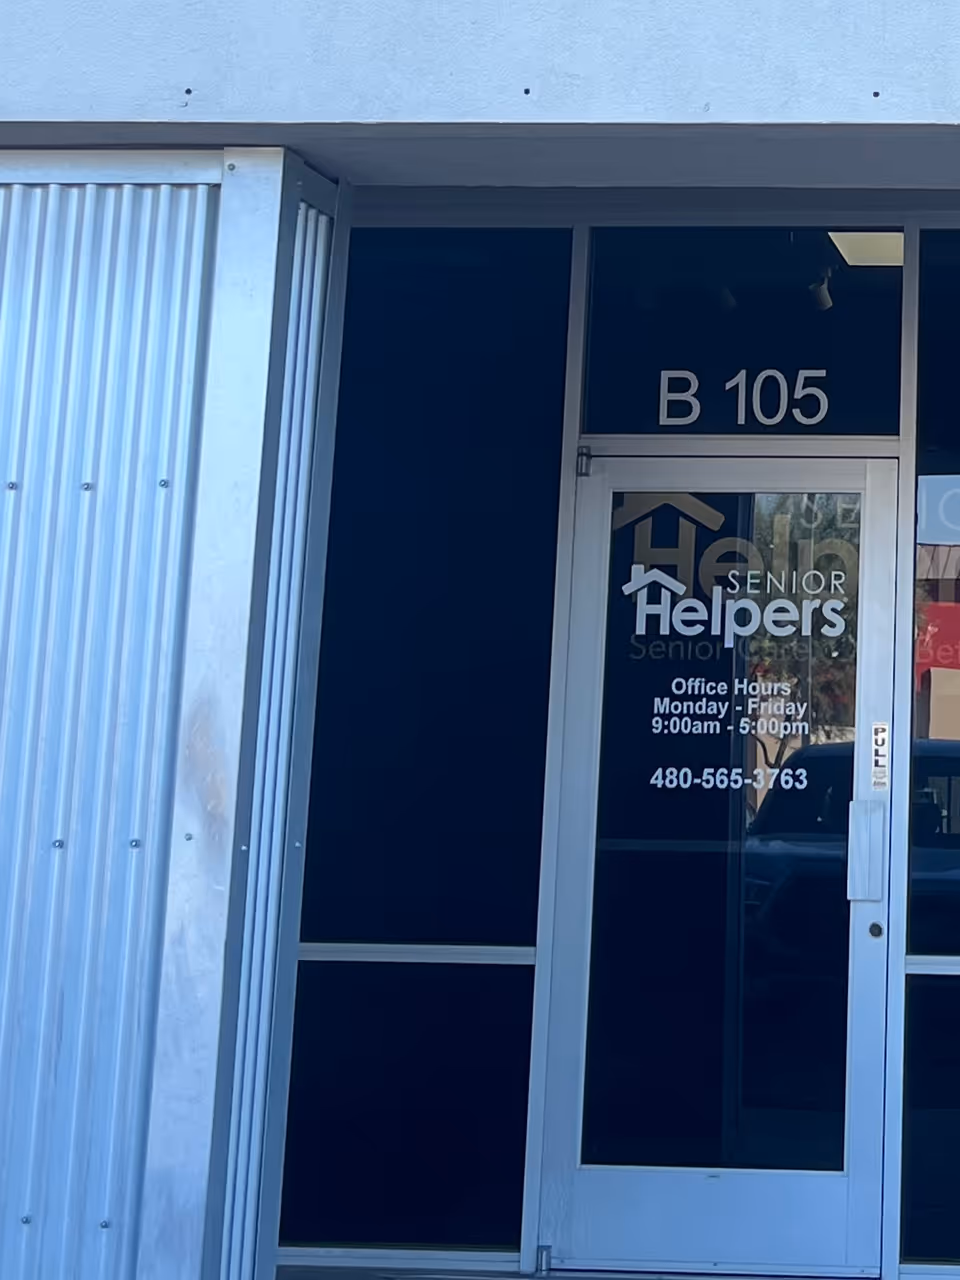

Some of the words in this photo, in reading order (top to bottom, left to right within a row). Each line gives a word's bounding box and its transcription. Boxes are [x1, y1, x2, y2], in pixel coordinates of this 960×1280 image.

[658, 370, 701, 426] B
[724, 369, 829, 426] 105
[726, 570, 846, 595] SENIOR
[635, 585, 847, 649] Helpers
[629, 633, 723, 661] Senior
[671, 677, 728, 696] Office
[734, 678, 792, 696] Hours
[653, 697, 729, 719] Monday
[747, 698, 808, 720] Friday
[651, 717, 721, 734] 9:00am
[739, 718, 809, 738] 5:00pm
[873, 727, 887, 768] PULL
[649, 768, 808, 789] 480-565-3763
